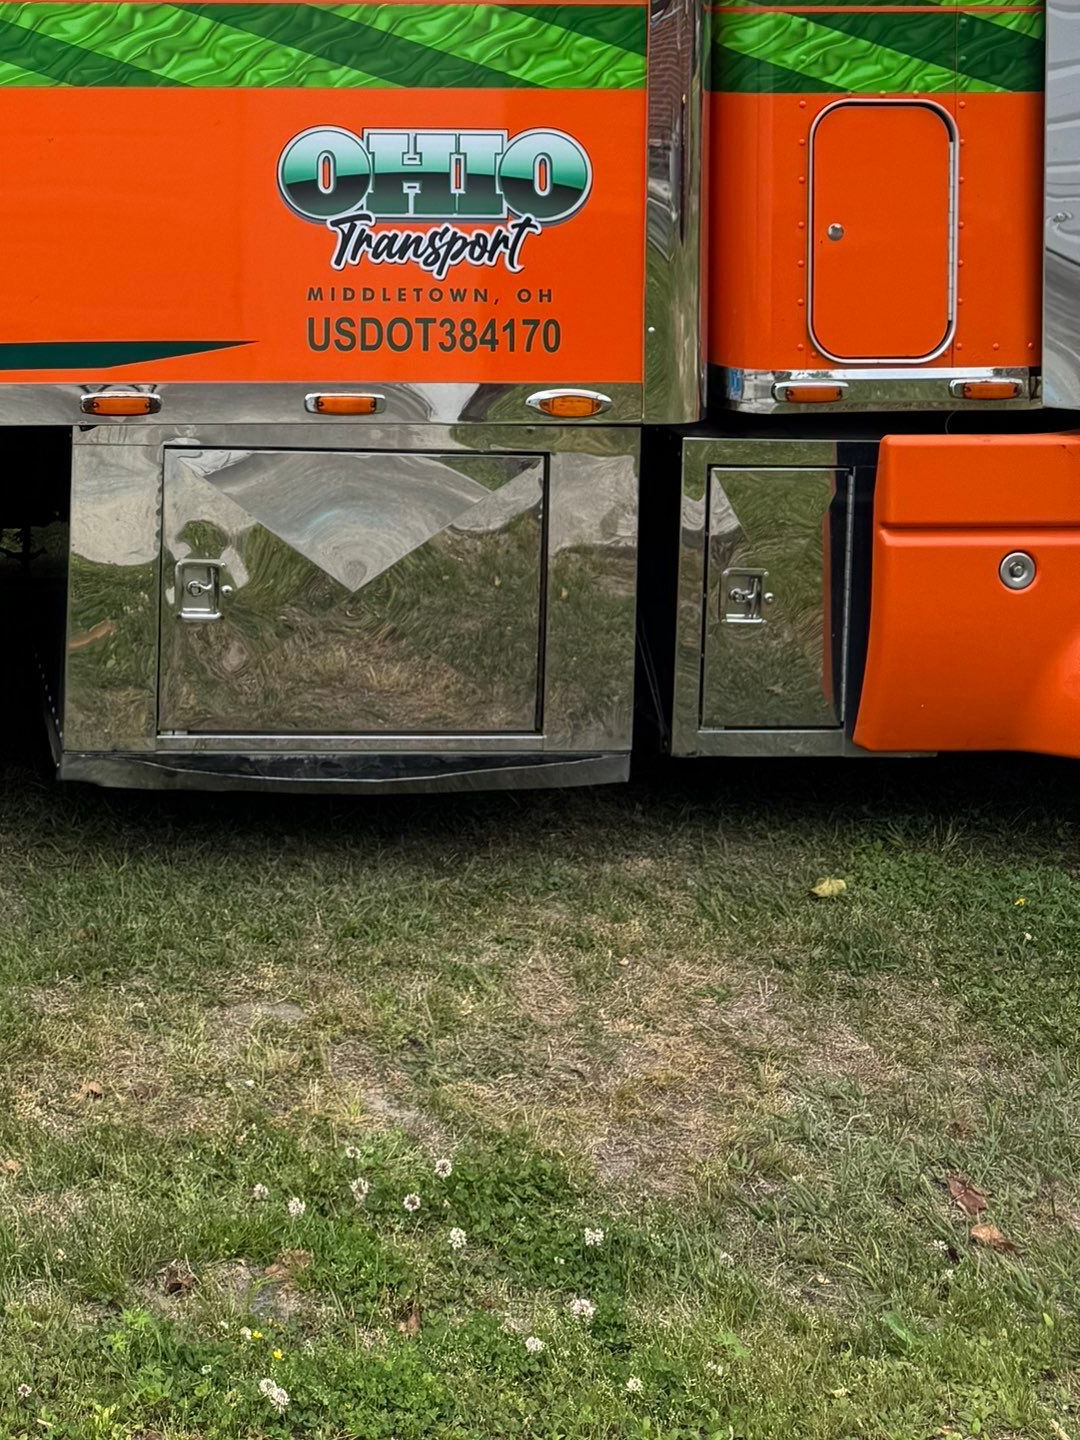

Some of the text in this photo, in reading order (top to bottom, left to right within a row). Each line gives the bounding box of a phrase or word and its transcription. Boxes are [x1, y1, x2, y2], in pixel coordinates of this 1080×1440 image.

[277, 125, 593, 224] OHIO
[327, 211, 542, 280] Transport
[307, 287, 553, 306] MIDDLETOWN, OH
[306, 316, 562, 353] USDOT384170
